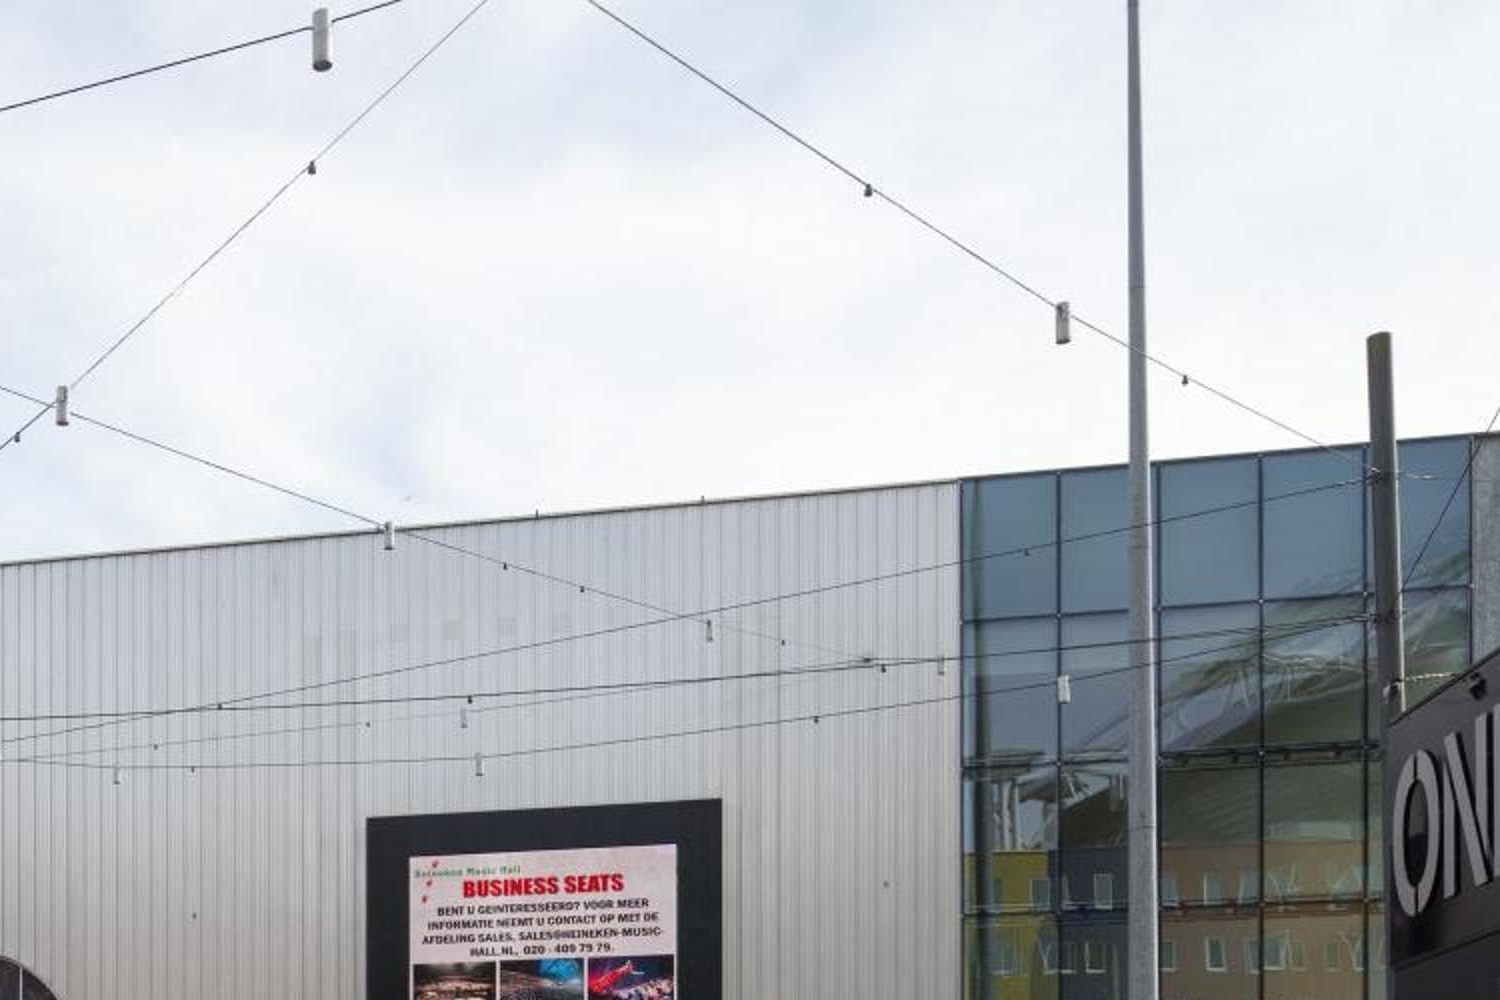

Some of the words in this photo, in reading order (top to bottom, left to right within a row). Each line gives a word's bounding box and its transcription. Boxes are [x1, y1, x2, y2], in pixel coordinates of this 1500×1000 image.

[1393, 703, 1500, 917] ON
[463, 877, 559, 898] BUSINESS
[564, 873, 624, 893] SEATS
[437, 905, 464, 916] BENT
[467, 905, 476, 915] U
[583, 900, 614, 910] VOOR
[617, 898, 649, 909] MEER
[428, 919, 494, 931] INFORMATIE
[496, 917, 533, 928] NEEMT
[536, 917, 545, 926] U
[547, 915, 596, 926] CONTACT
[600, 914, 615, 924] OP
[617, 913, 641, 923] MET
[644, 911, 660, 921] DE
[422, 933, 476, 945] AFDELING
[523, 945, 546, 955] 020
